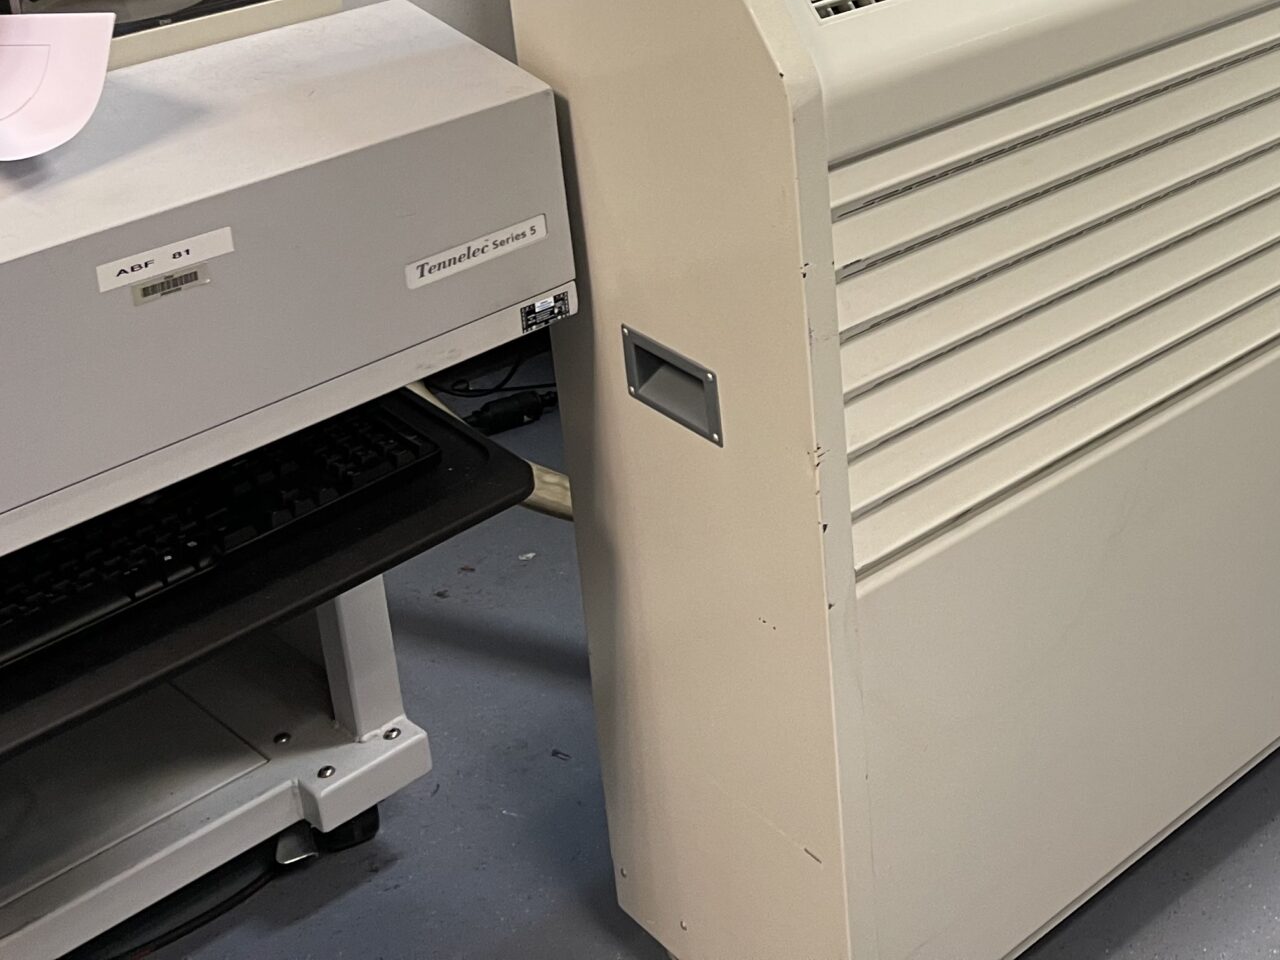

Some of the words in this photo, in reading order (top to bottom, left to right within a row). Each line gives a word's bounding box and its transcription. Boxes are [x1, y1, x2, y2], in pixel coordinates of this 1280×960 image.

[116, 259, 155, 277] ABF
[172, 248, 191, 259] 81
[416, 244, 489, 279] Tennelec
[492, 232, 527, 250] Series
[530, 225, 537, 235] 5
